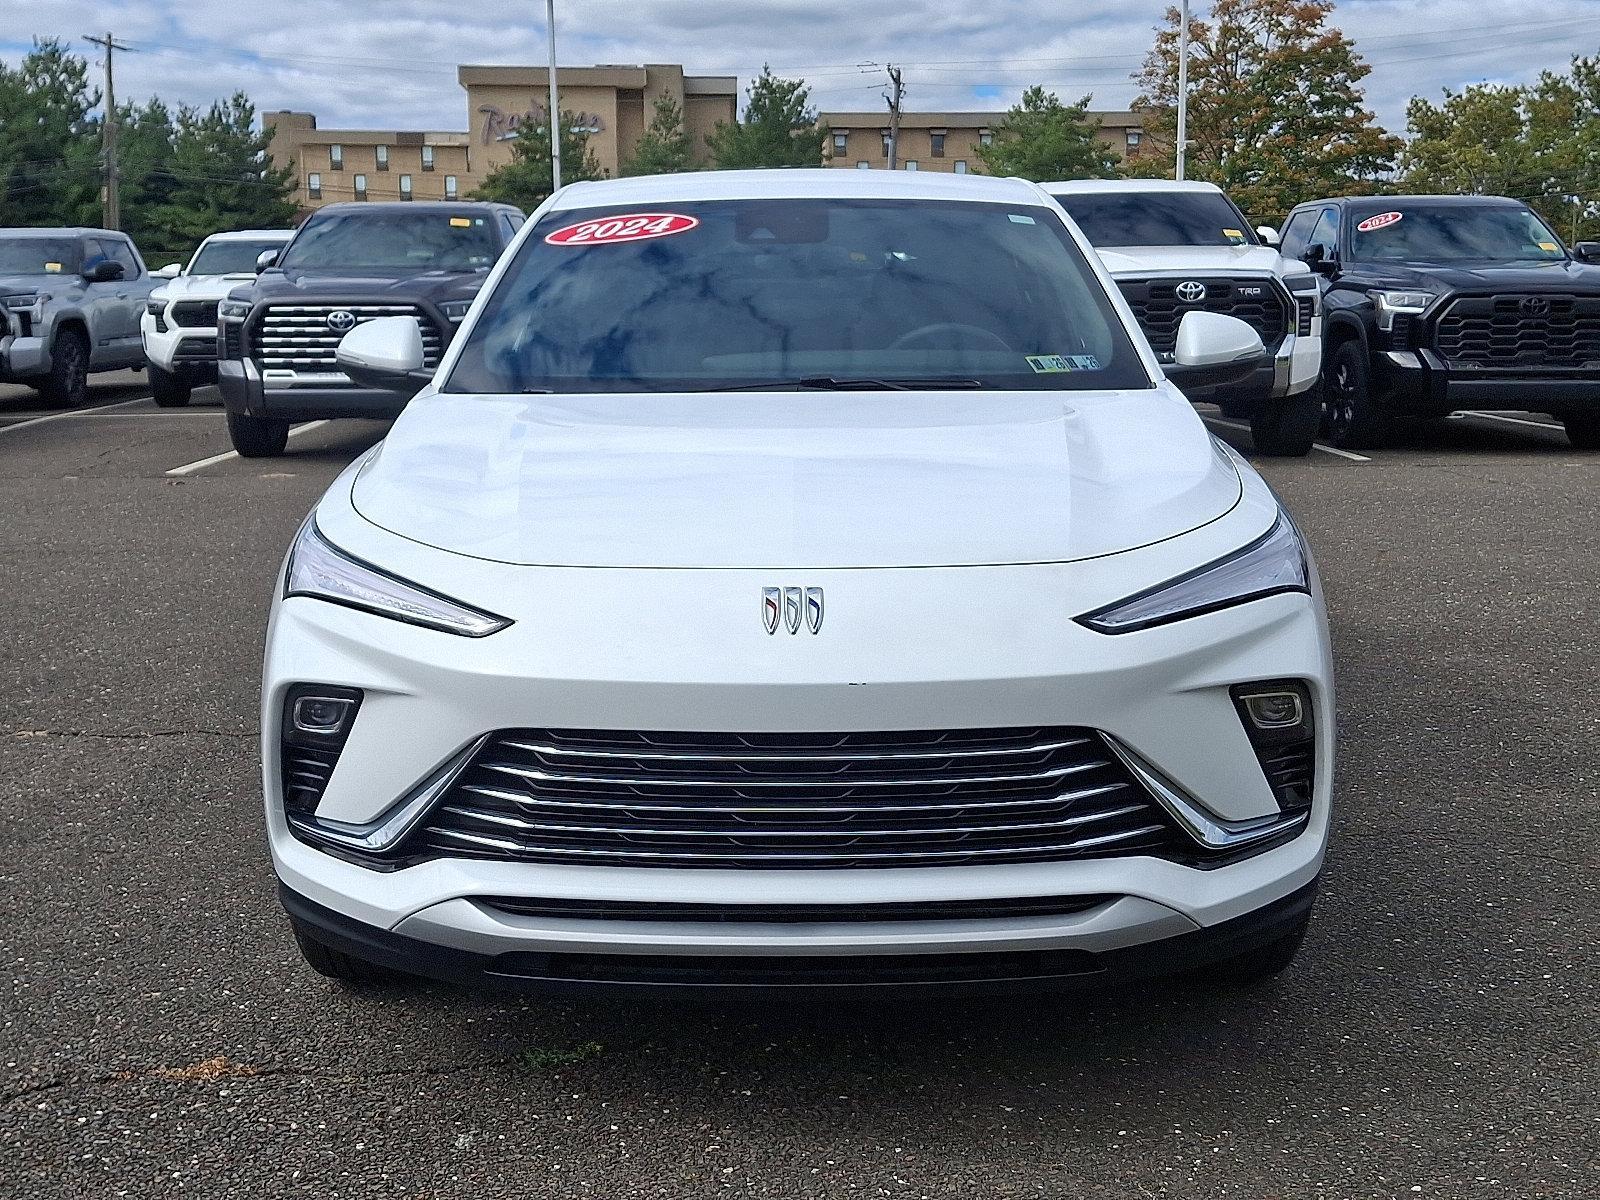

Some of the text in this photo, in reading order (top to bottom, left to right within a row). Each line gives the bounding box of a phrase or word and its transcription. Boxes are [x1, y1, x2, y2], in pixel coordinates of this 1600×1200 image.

[1366, 213, 1392, 228] 2024
[566, 216, 675, 243] 2024
[1237, 287, 1261, 297] TRD
